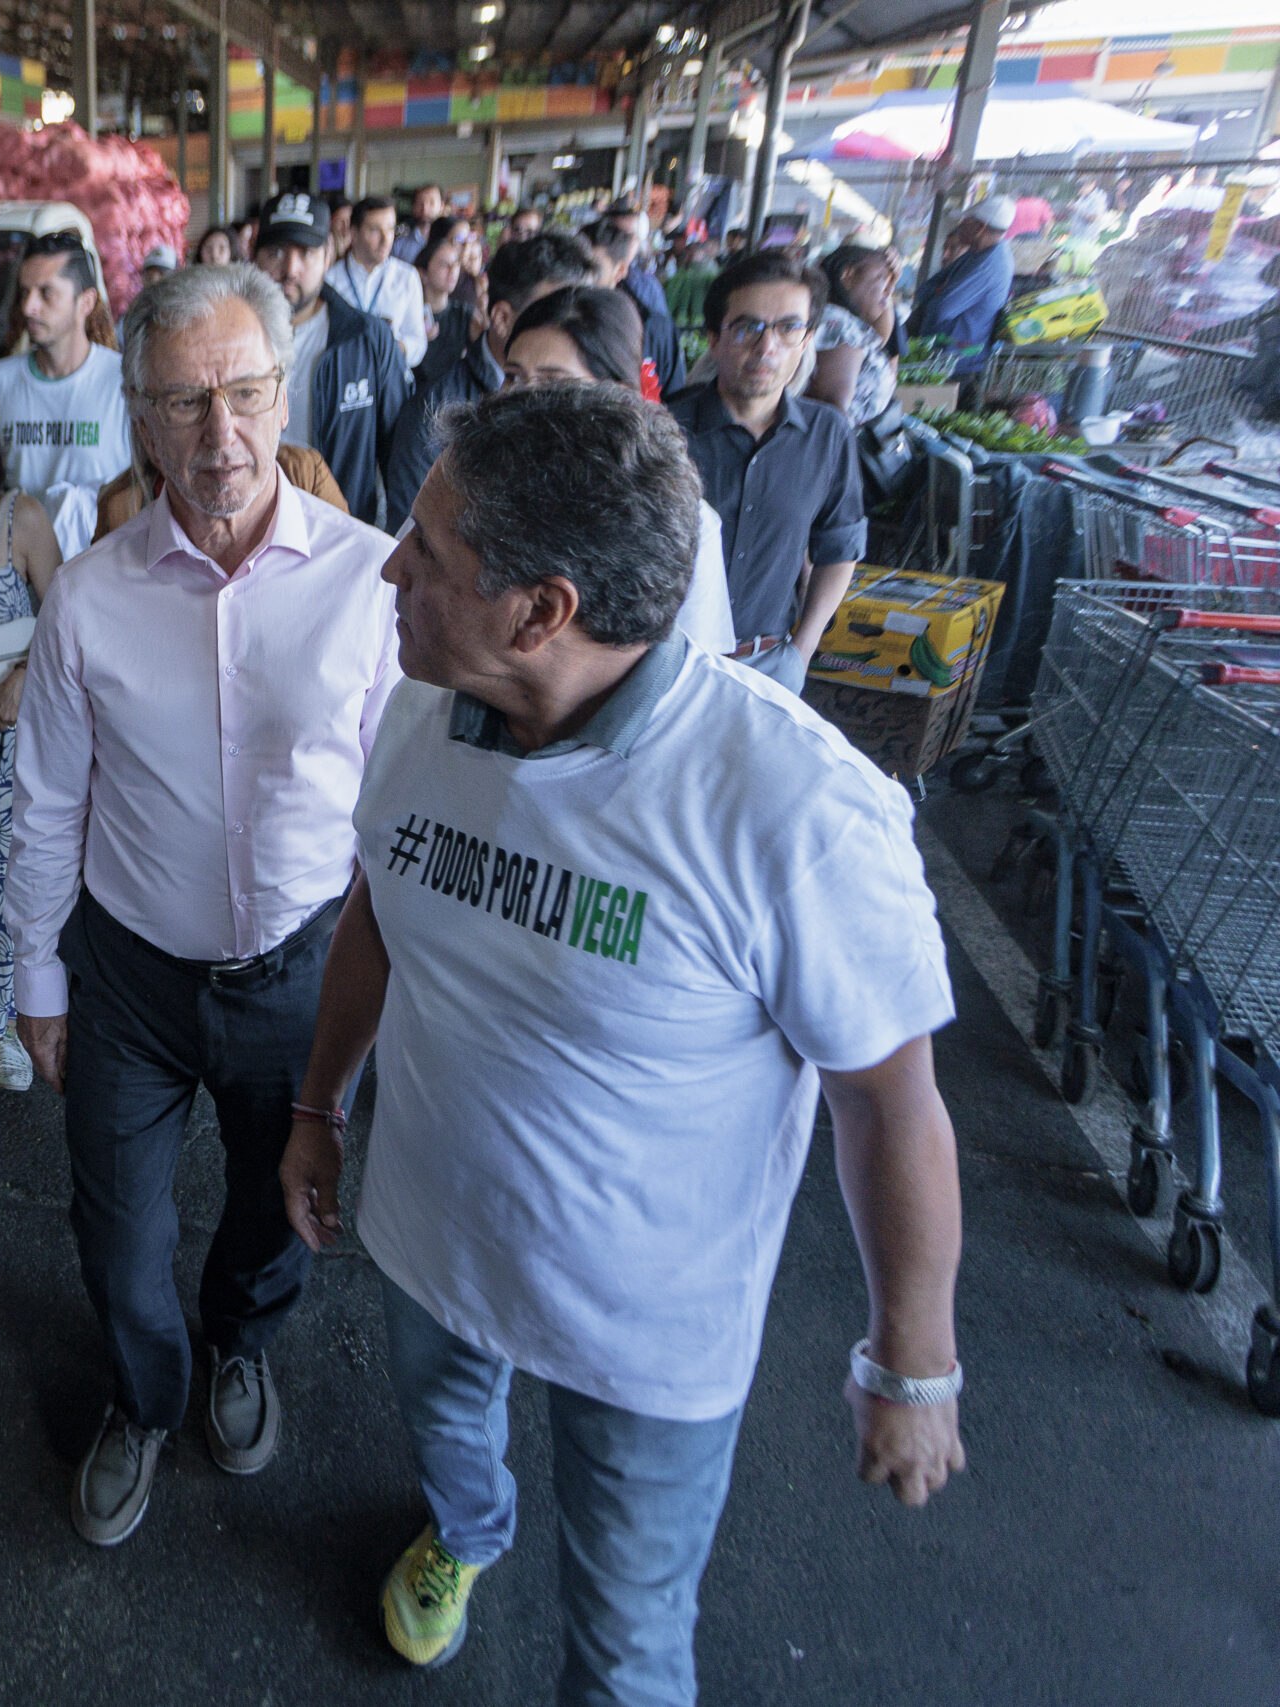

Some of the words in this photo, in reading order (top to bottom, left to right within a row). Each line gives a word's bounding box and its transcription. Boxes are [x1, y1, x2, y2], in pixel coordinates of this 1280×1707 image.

[46, 421, 62, 446] POR
[63, 421, 74, 446] LA
[75, 420, 99, 446] VEGA
[486, 847, 539, 928] POR
[532, 863, 573, 941] LA
[568, 874, 648, 965] VEGA
